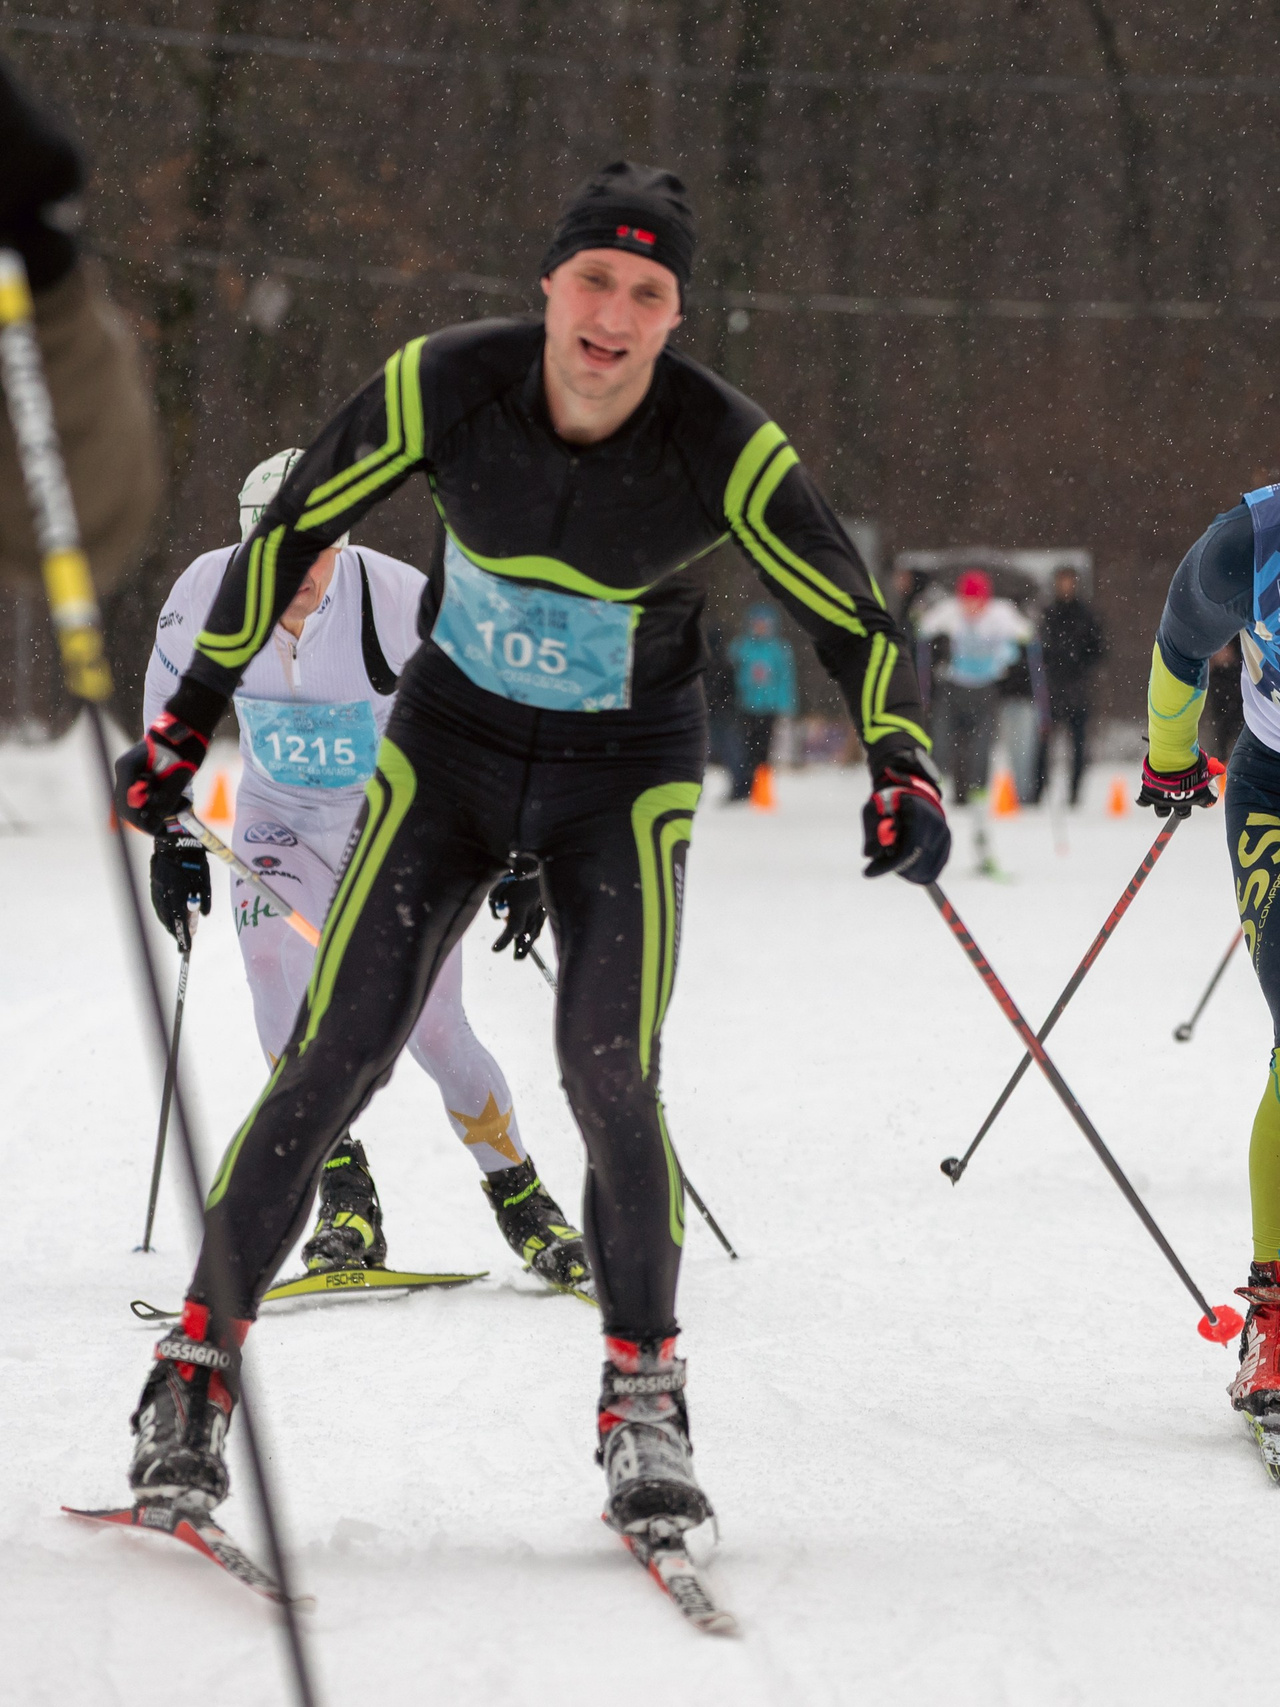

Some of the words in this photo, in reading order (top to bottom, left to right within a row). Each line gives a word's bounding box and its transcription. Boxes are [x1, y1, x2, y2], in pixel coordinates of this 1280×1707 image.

[476, 620, 568, 675] 105
[265, 732, 356, 766] 1215
[326, 1272, 366, 1287] FISCHER
